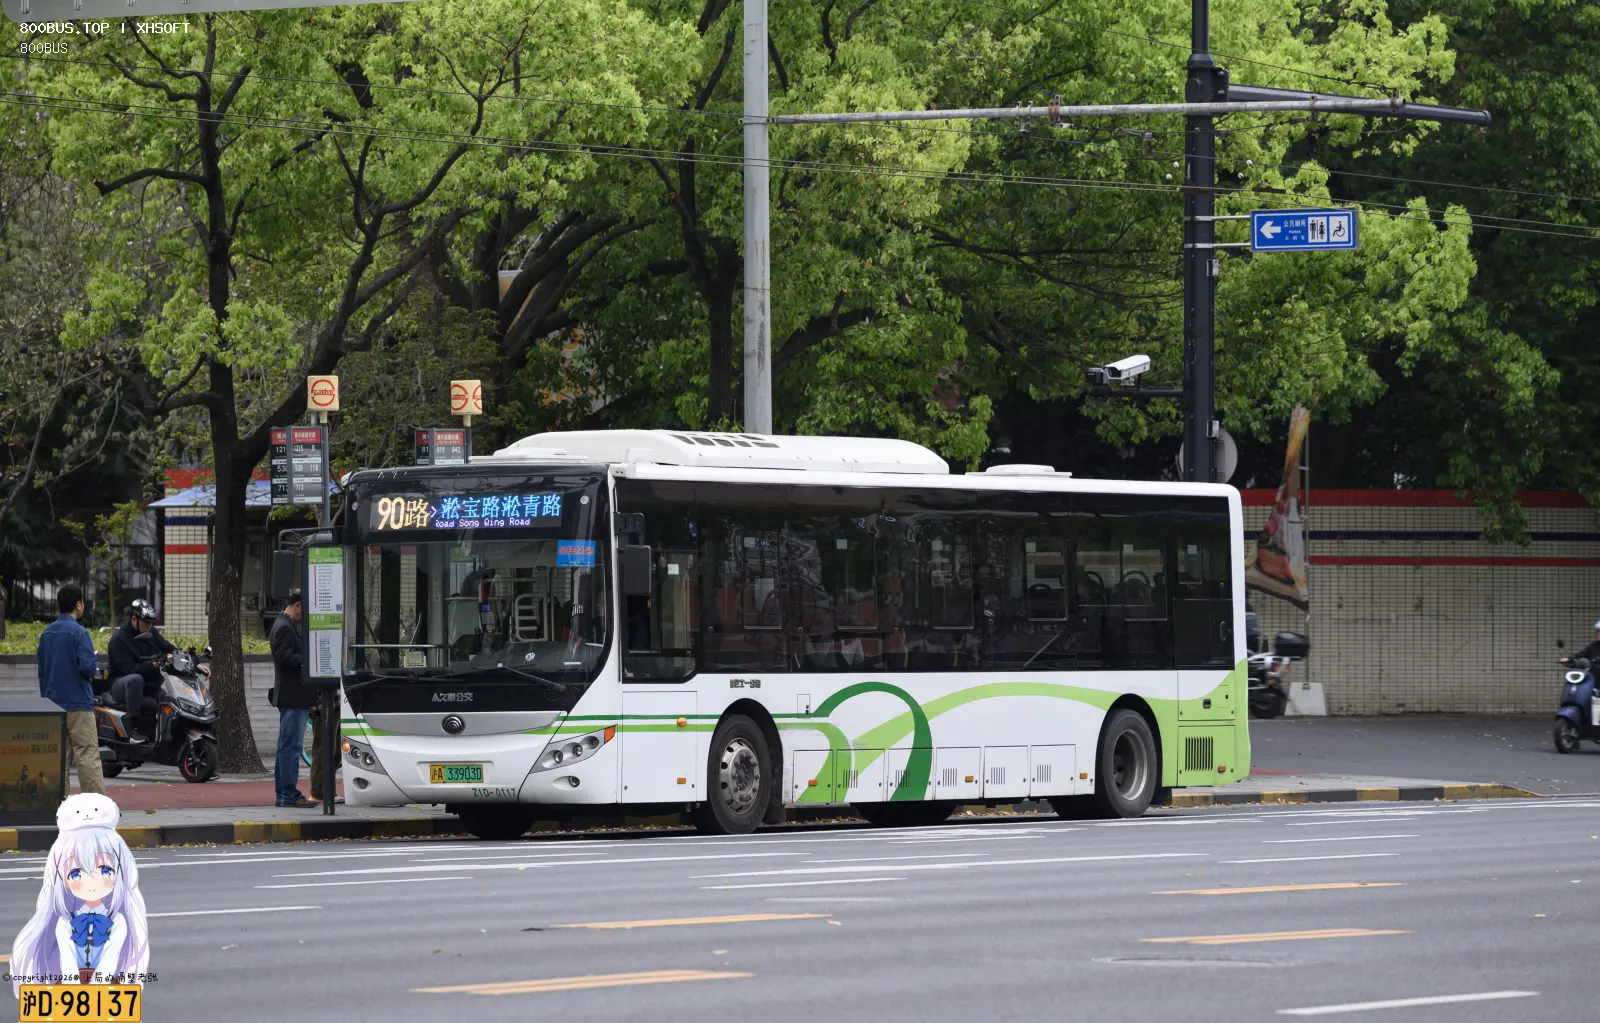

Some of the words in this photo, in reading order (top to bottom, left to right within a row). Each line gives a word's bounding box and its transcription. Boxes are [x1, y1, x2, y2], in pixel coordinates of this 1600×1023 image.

[451, 446, 461, 454] 842
[295, 483, 304, 491] 713
[378, 497, 429, 530] 90路
[440, 494, 562, 519] 淞宝路淞青路
[458, 519, 480, 528] Song
[483, 518, 505, 527] Qing
[509, 517, 531, 526] Road
[447, 767, 482, 781] 33903D
[472, 788, 516, 798] Z1D-0117
